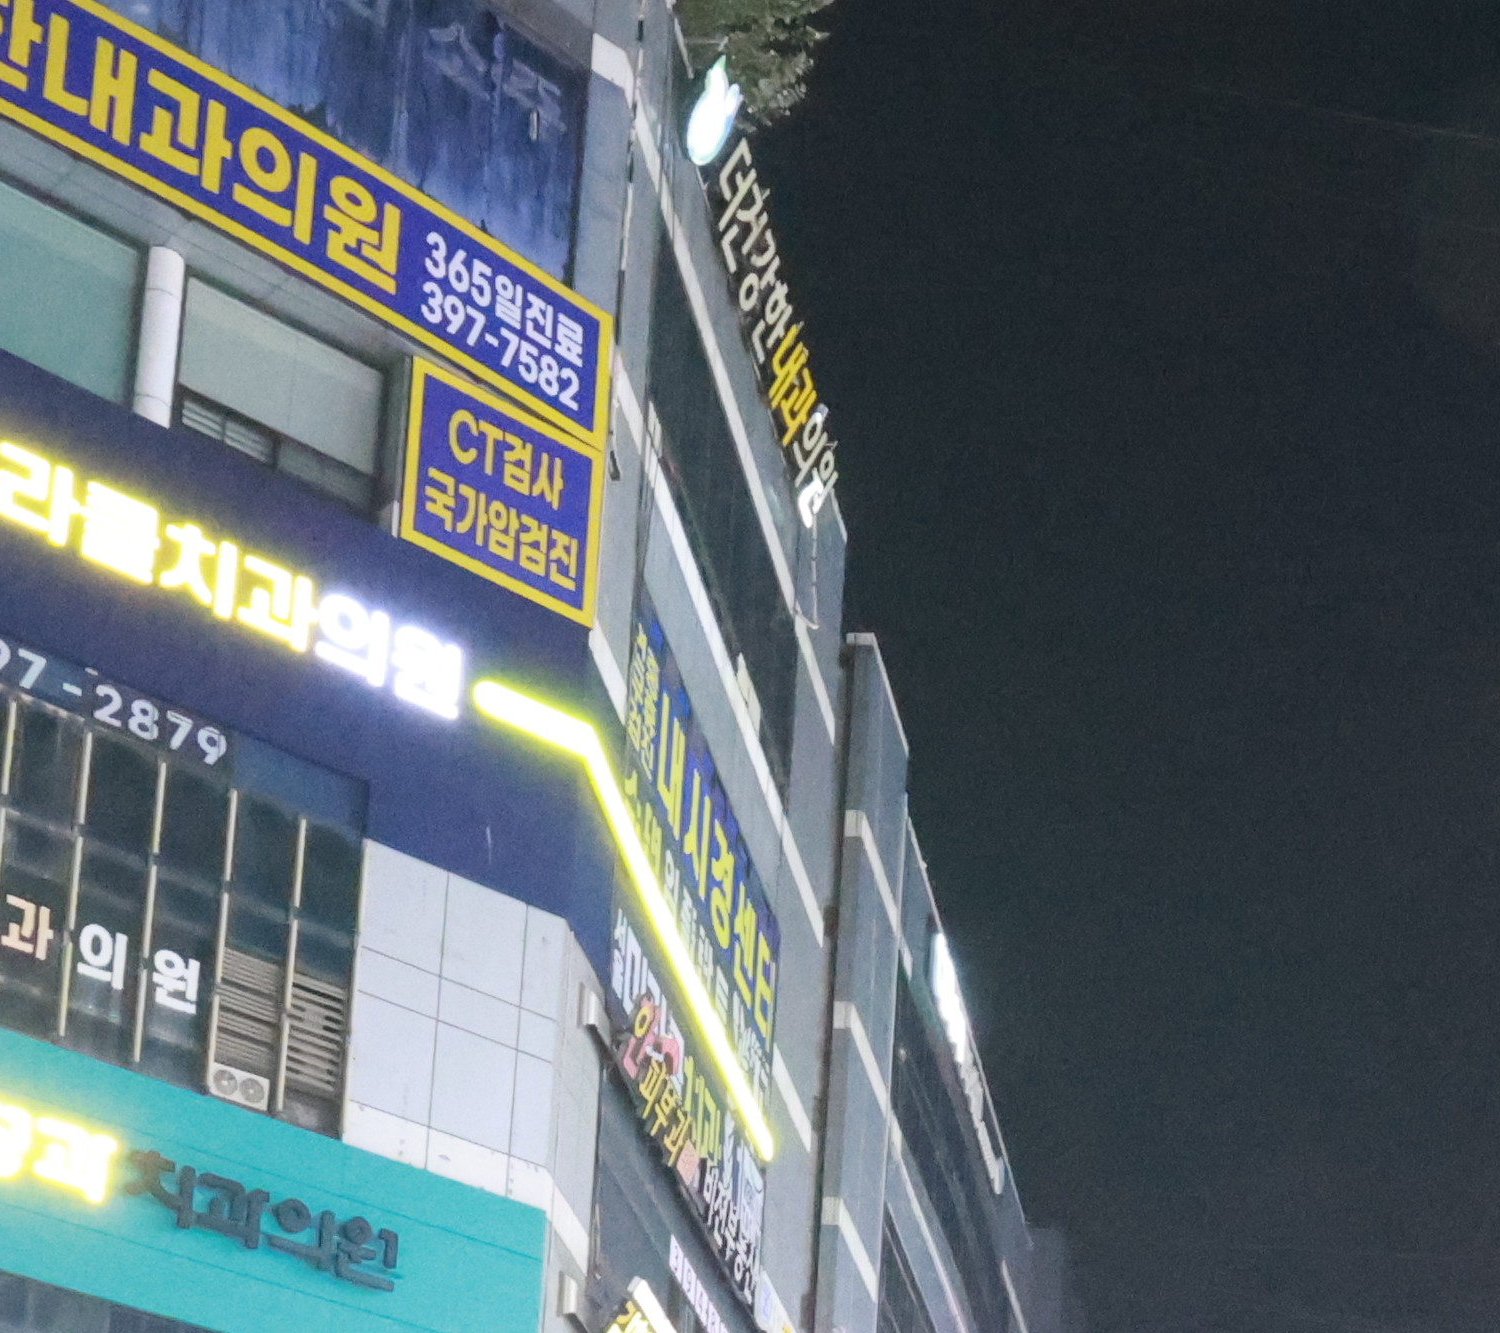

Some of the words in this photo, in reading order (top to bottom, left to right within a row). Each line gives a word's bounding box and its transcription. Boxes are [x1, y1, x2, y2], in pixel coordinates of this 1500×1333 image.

[422, 289, 580, 411] 397-7582
[425, 232, 584, 368] 365일진료
[447, 410, 564, 510] CT검사
[424, 471, 580, 592] 국가암검진
[125, 1149, 399, 1293] 치과의원
